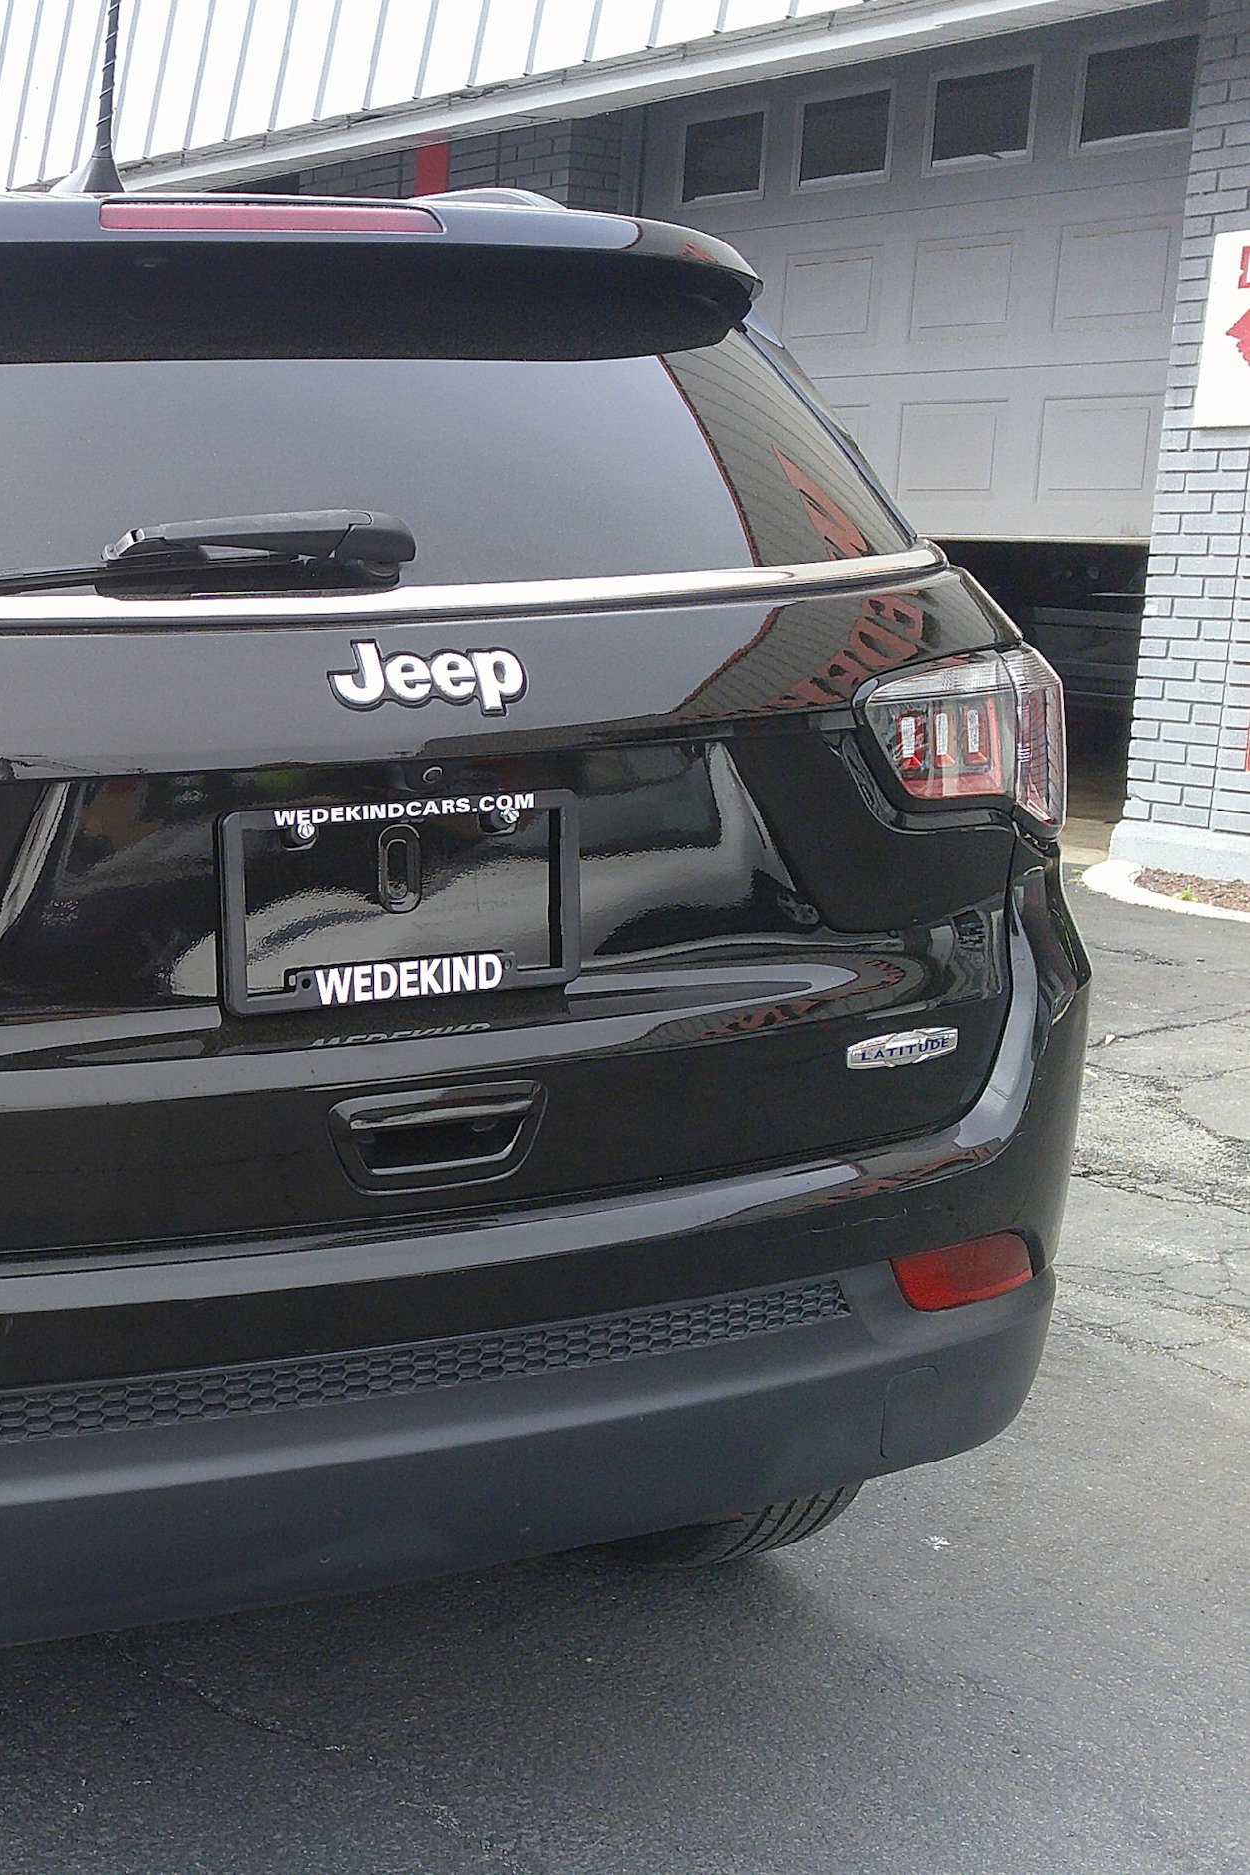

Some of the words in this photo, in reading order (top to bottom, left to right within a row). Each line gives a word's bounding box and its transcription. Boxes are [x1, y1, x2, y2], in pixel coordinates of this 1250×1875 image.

[327, 639, 528, 717] Jeep
[274, 793, 535, 826] WEDEKINDCARS.COM
[315, 953, 502, 1006] WEDEKIND
[861, 1037, 950, 1060] LATITUDE
